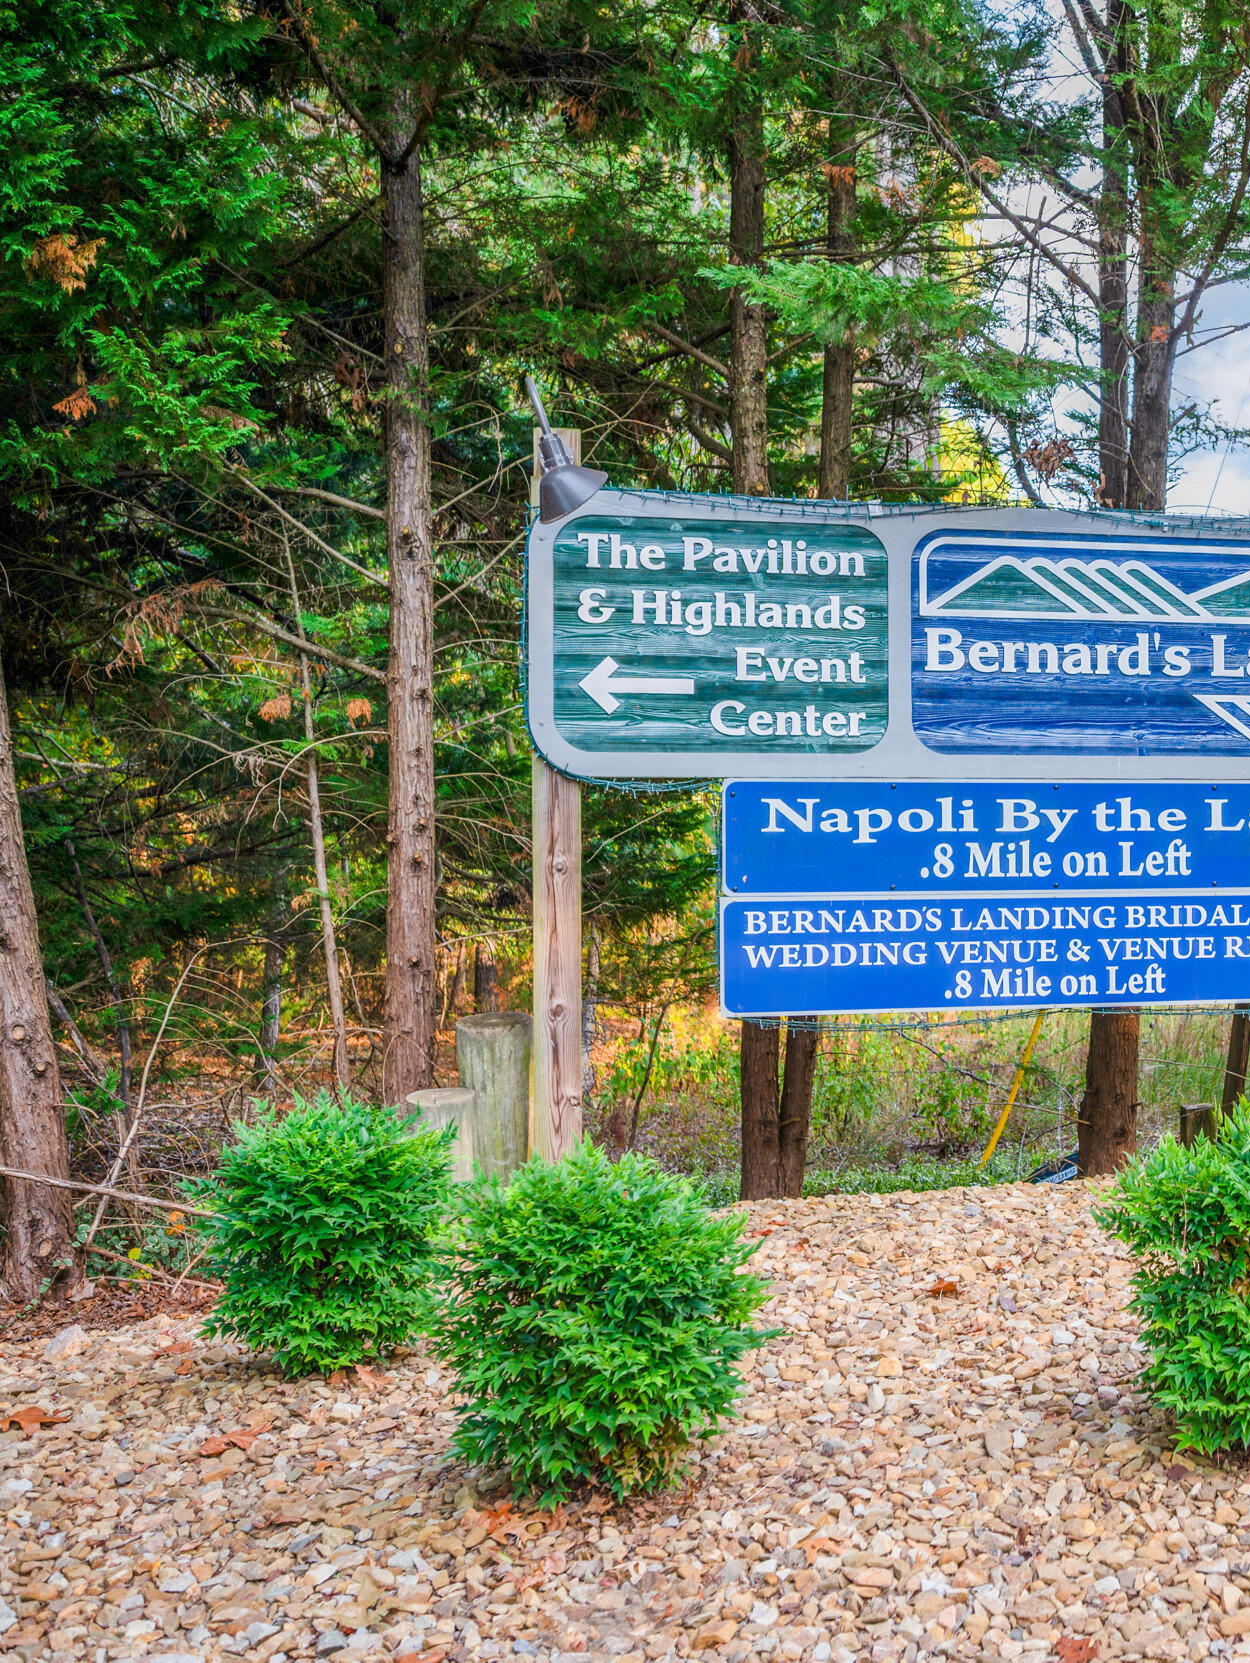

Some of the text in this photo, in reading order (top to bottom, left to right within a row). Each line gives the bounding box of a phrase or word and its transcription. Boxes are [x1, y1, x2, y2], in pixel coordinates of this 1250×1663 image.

[577, 532, 866, 577] The Pavilion
[577, 588, 866, 636] & Highlands
[734, 646, 867, 684] Event
[924, 627, 1191, 677] Bernard's
[709, 700, 867, 737] Center
[760, 796, 980, 844] Napoli
[995, 798, 1079, 843] By
[1091, 796, 1188, 832] the
[919, 838, 1192, 879] .8 Mile on Left
[743, 906, 943, 935] BERNARD'S
[950, 905, 1117, 932] LANDING
[1124, 904, 1250, 928] BRIDAL
[742, 941, 928, 968] WEDDING
[935, 938, 1058, 964] VENUE
[1066, 938, 1091, 962] &
[1097, 936, 1216, 961] VENUE
[944, 963, 1167, 999] .8 Mile on Left
